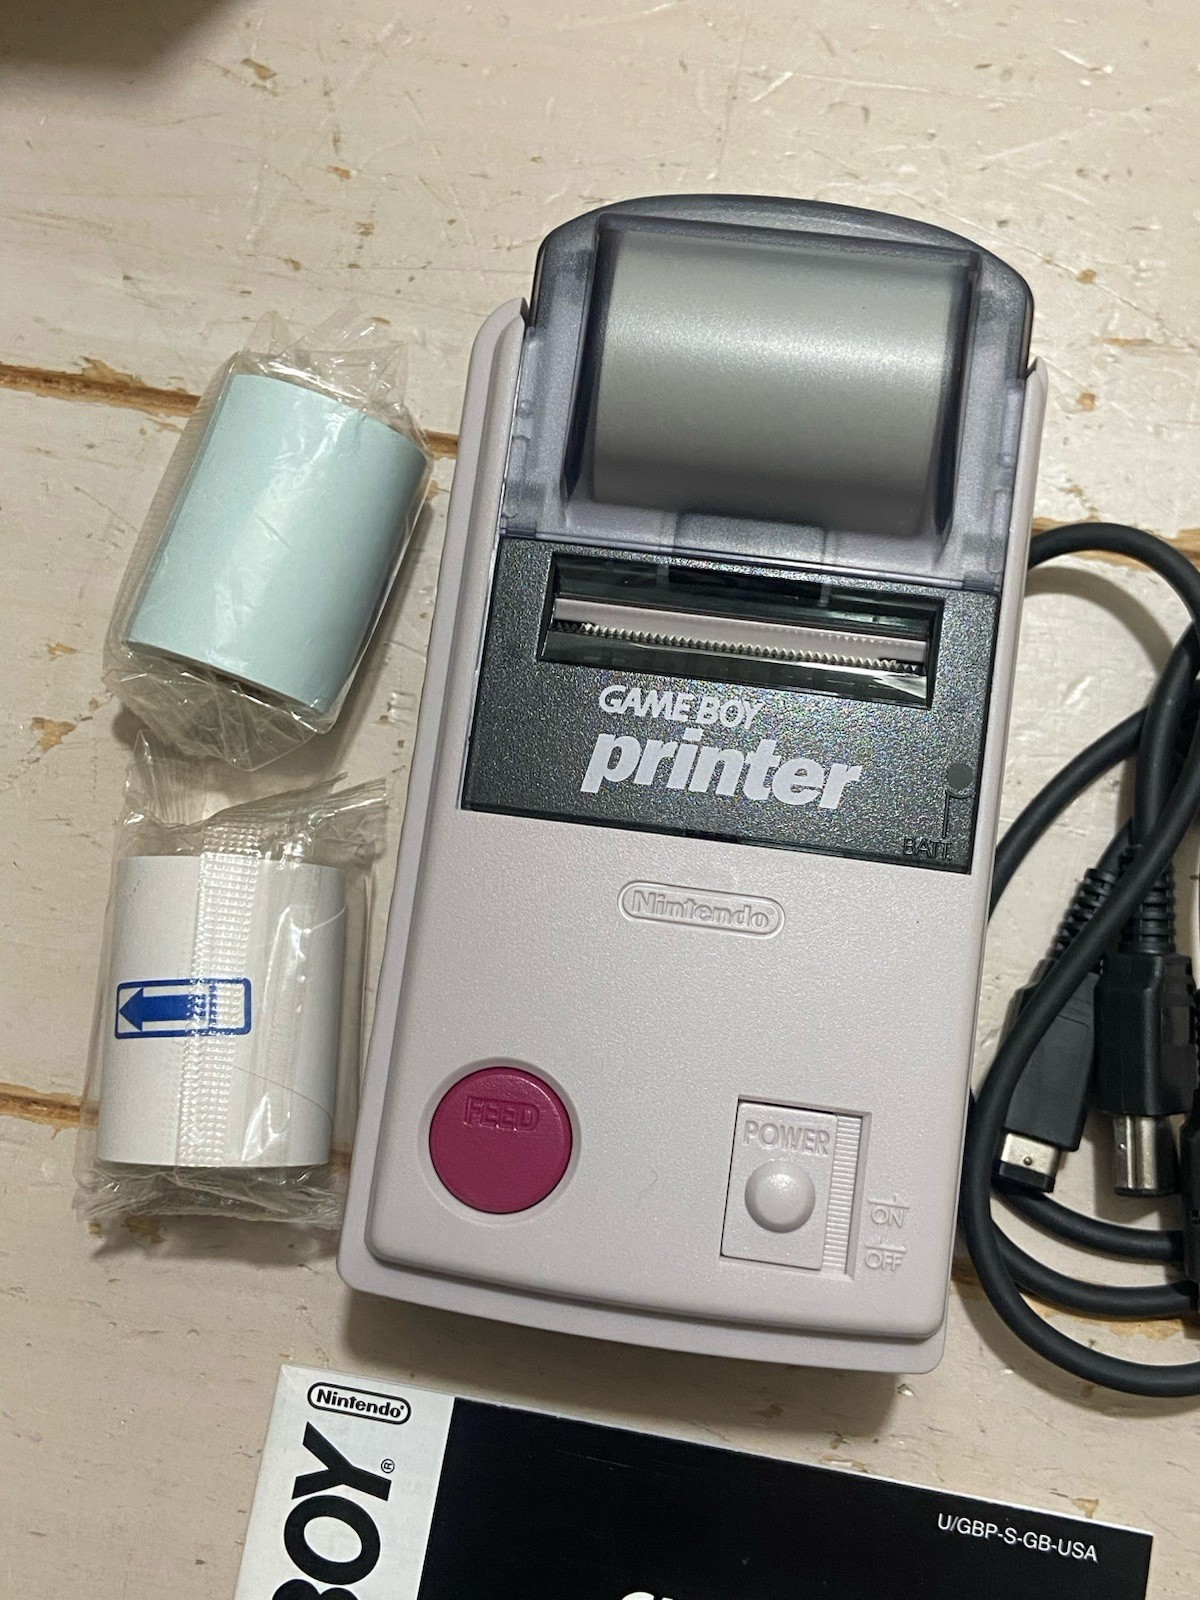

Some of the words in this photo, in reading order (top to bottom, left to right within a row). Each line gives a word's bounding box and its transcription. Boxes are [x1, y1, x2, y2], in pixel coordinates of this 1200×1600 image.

[598, 684, 696, 723] GAME
[696, 695, 764, 730] BOY
[580, 728, 862, 810] printer
[631, 888, 770, 930] Nintendo
[463, 1095, 541, 1132] FEED
[743, 1119, 834, 1157] POWER
[871, 1206, 904, 1229] ON
[864, 1249, 903, 1271] OFF
[316, 1388, 402, 1418] Nintendo
[937, 1512, 1099, 1563] U/GBP-S-GB-USA
